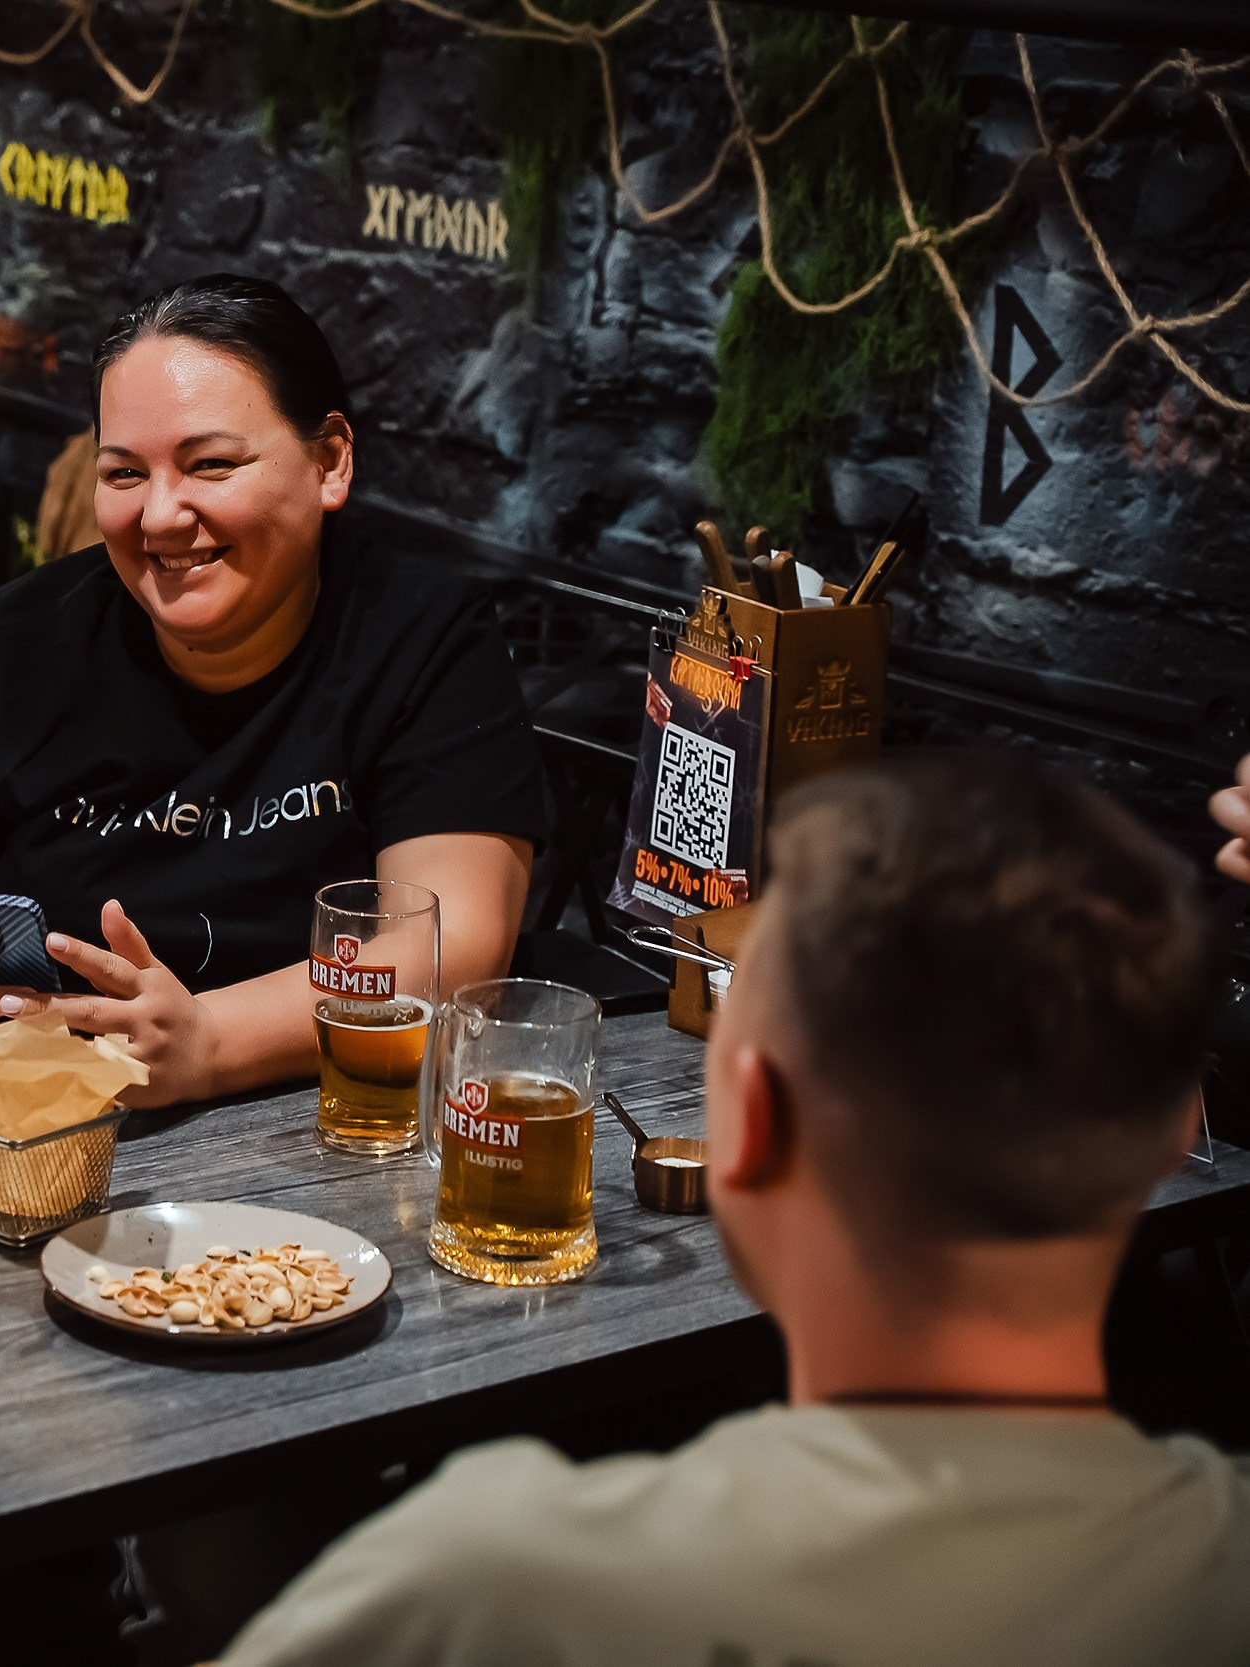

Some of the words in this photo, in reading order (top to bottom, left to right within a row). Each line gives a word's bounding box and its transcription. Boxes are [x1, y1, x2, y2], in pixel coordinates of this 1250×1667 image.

[787, 711, 870, 742] VIKING
[311, 961, 392, 995] BREMEN
[444, 1102, 521, 1148] BREMEN
